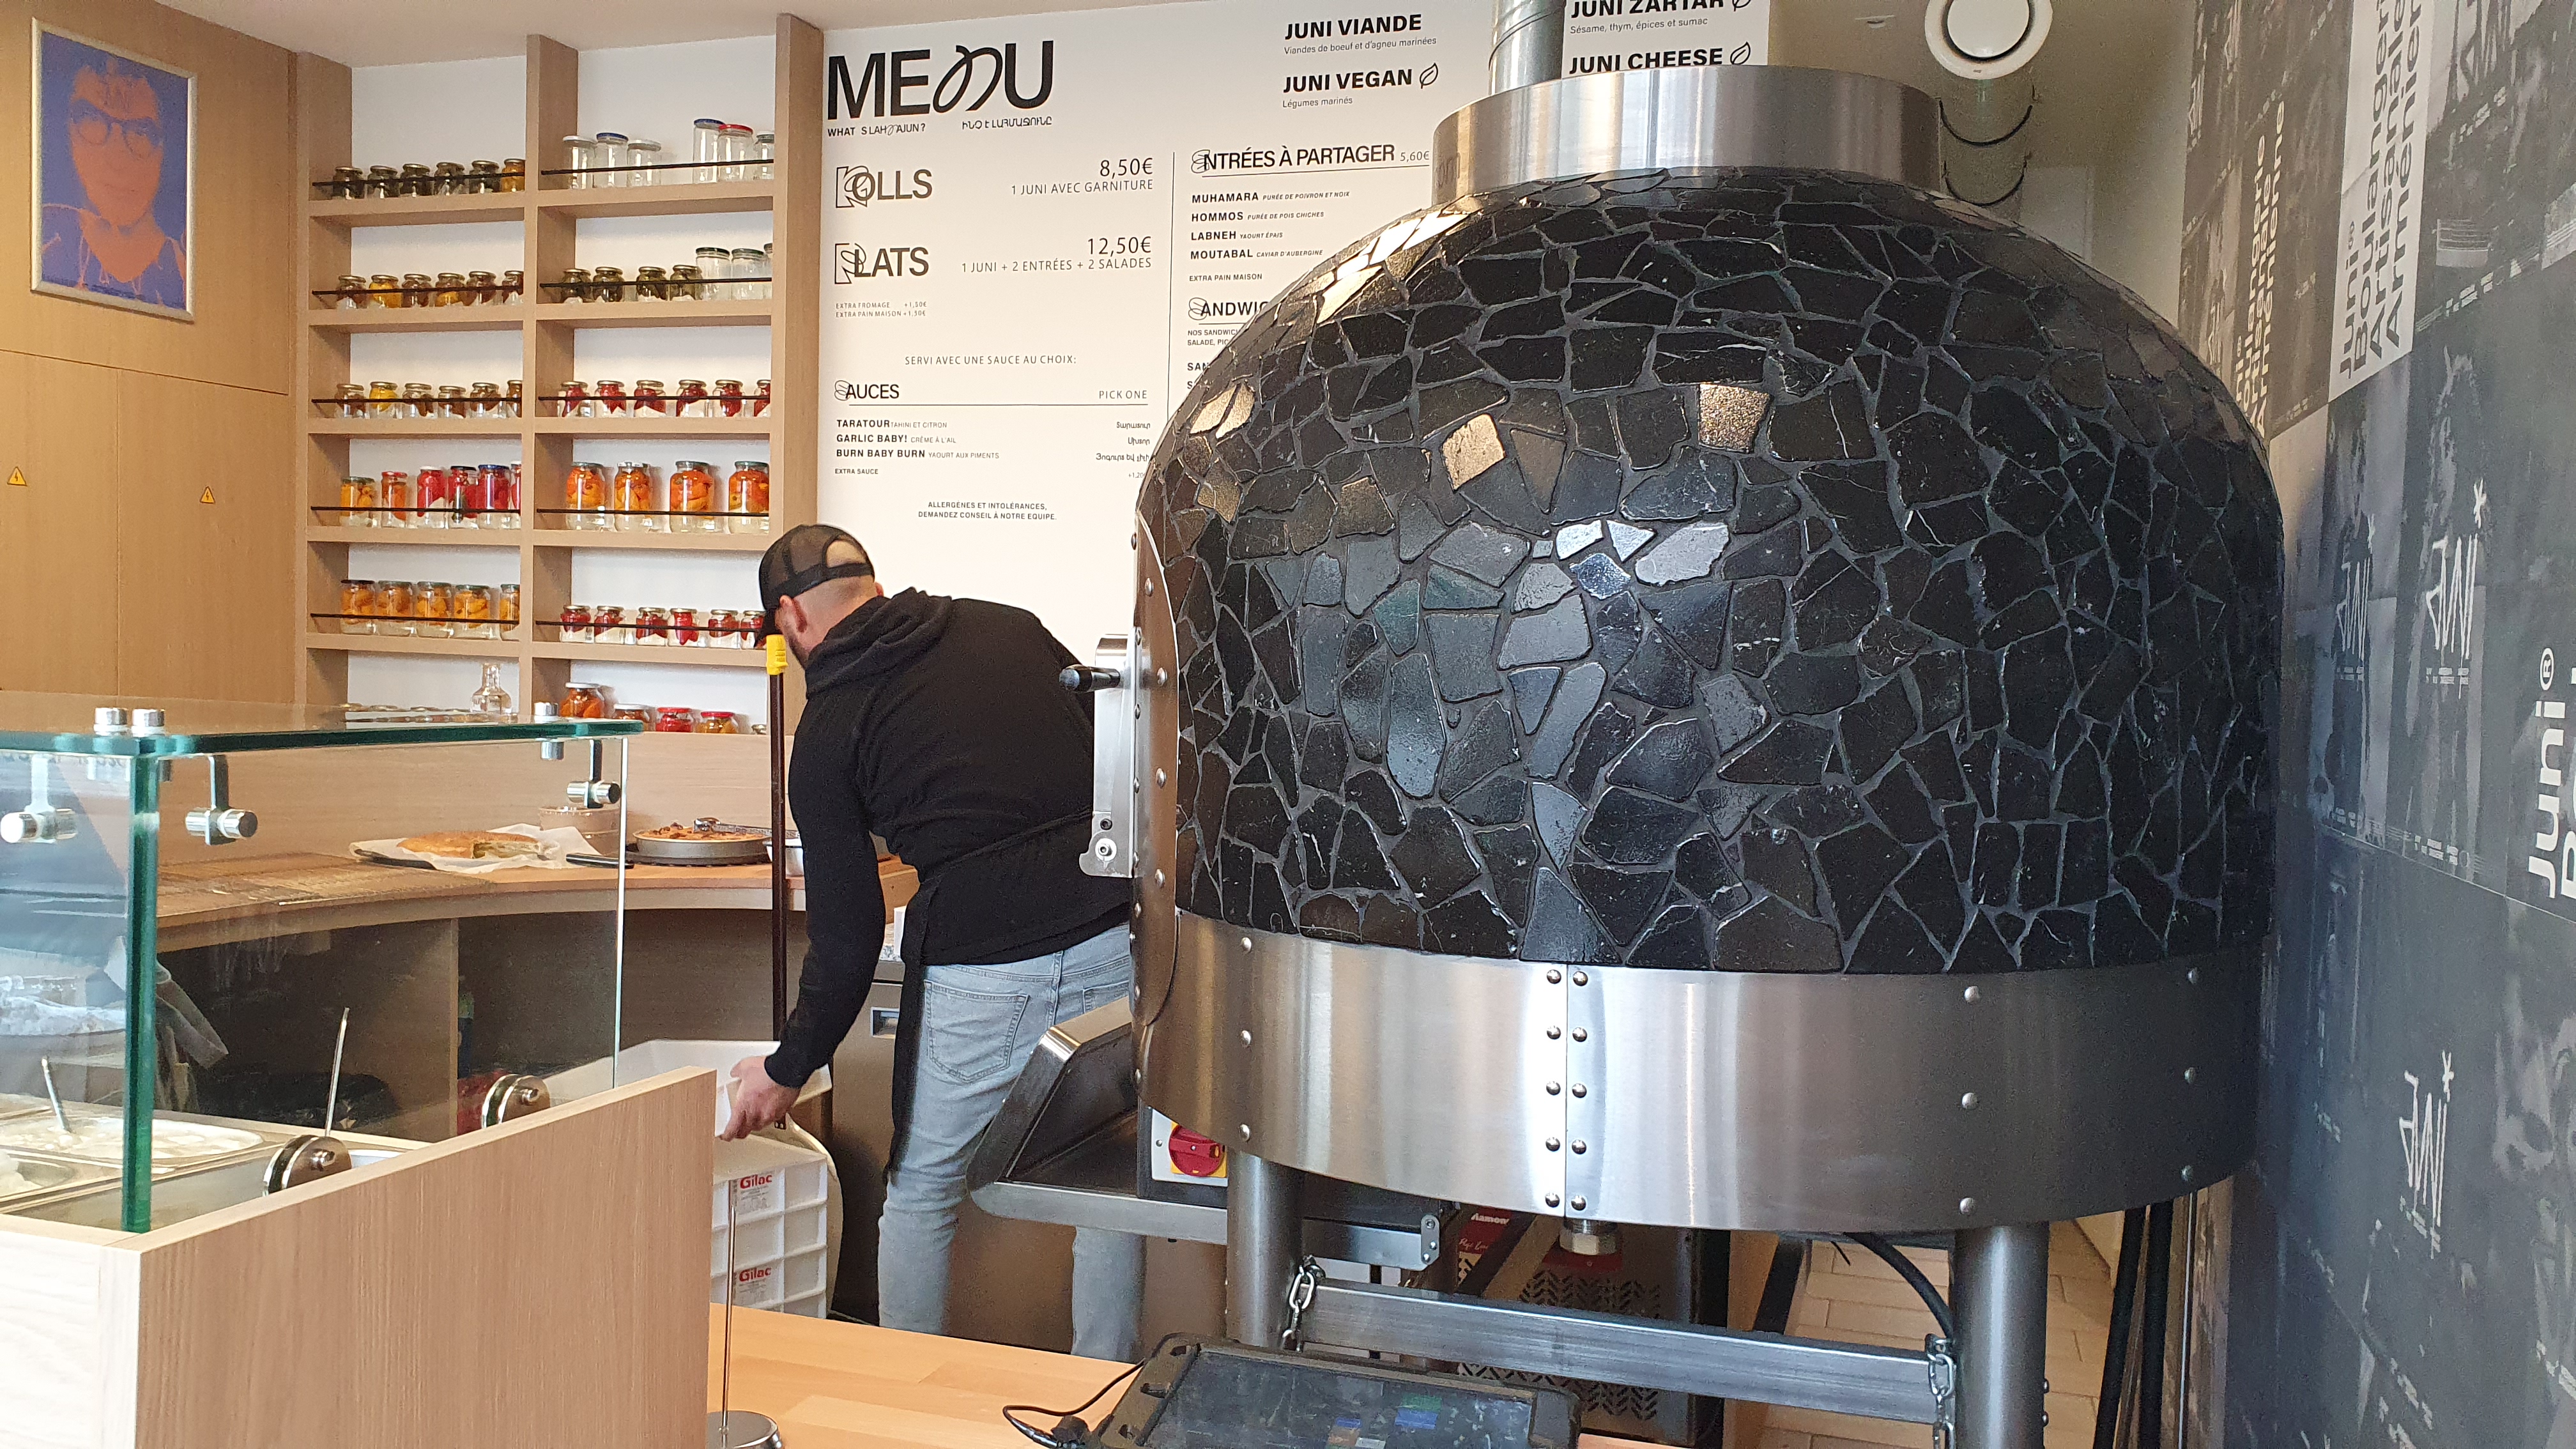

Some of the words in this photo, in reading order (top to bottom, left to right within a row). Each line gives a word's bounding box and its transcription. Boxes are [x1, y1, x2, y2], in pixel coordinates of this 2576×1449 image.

[1284, 20, 1332, 40] JUNI
[1337, 13, 1422, 36] VIANDE
[1570, 25, 1607, 34] Sésame,
[1609, 22, 1634, 33] thym,
[1636, 20, 1665, 31] épices
[1667, 19, 1676, 27] et
[1678, 18, 1708, 27] sumac
[1284, 45, 1316, 55] Viandes
[1330, 42, 1354, 52] boeuf
[1354, 42, 1363, 50] et
[1399, 36, 1437, 47] marinées
[1569, 55, 1620, 74] JUNI
[1627, 48, 1723, 70] CHEESE
[1283, 73, 1330, 93] JUNI
[1335, 68, 1413, 90] VEGAN
[1282, 98, 1319, 109] Légumes
[1321, 96, 1353, 106] marinés
[827, 126, 856, 137] WHAT
[1278, 145, 1293, 167] À
[1296, 144, 1395, 166] PARTAGER
[1100, 157, 1153, 180] 8,50€
[1011, 185, 1016, 195] 1
[1020, 183, 1046, 195] JUNI
[1050, 182, 1081, 194] AVEC
[1084, 180, 1153, 193] GARNITURE
[1192, 192, 1259, 204] MUHAMARA
[1191, 211, 1243, 222] HOMMOS
[1191, 230, 1236, 241] LABNEH
[1087, 236, 1151, 257] 12,50€
[1190, 249, 1254, 260] MOUTABAL
[962, 263, 966, 273] 1
[970, 261, 997, 273] JUNI
[1012, 261, 1018, 272] 2
[1023, 257, 1072, 272] ENTRÉES
[1088, 259, 1094, 270] 2
[1098, 256, 1151, 270] SALADES
[2242, 134, 2266, 414] oulangerie
[835, 302, 857, 310] EXTRA
[905, 356, 933, 365] SERVI
[935, 356, 961, 365] AVEC
[964, 355, 984, 365] UNE
[987, 355, 1020, 365] SAUCE
[1023, 355, 1037, 364] AU
[1039, 355, 1077, 364] CHOIX:
[1099, 390, 1123, 399] PICK
[1125, 390, 1147, 399] ONE
[836, 419, 890, 428] TARATOUR
[836, 434, 874, 443] GARLIC
[877, 434, 907, 443] BABY!
[836, 448, 864, 457] BURN
[867, 449, 894, 458] BABY
[897, 449, 925, 458] BURN
[928, 500, 976, 509] ALLERGÈNES
[988, 501, 1047, 511] INTOLÉRANCES,
[993, 510, 999, 519] À
[740, 1174, 772, 1189] Gilac
[739, 1267, 772, 1282] Gilac
